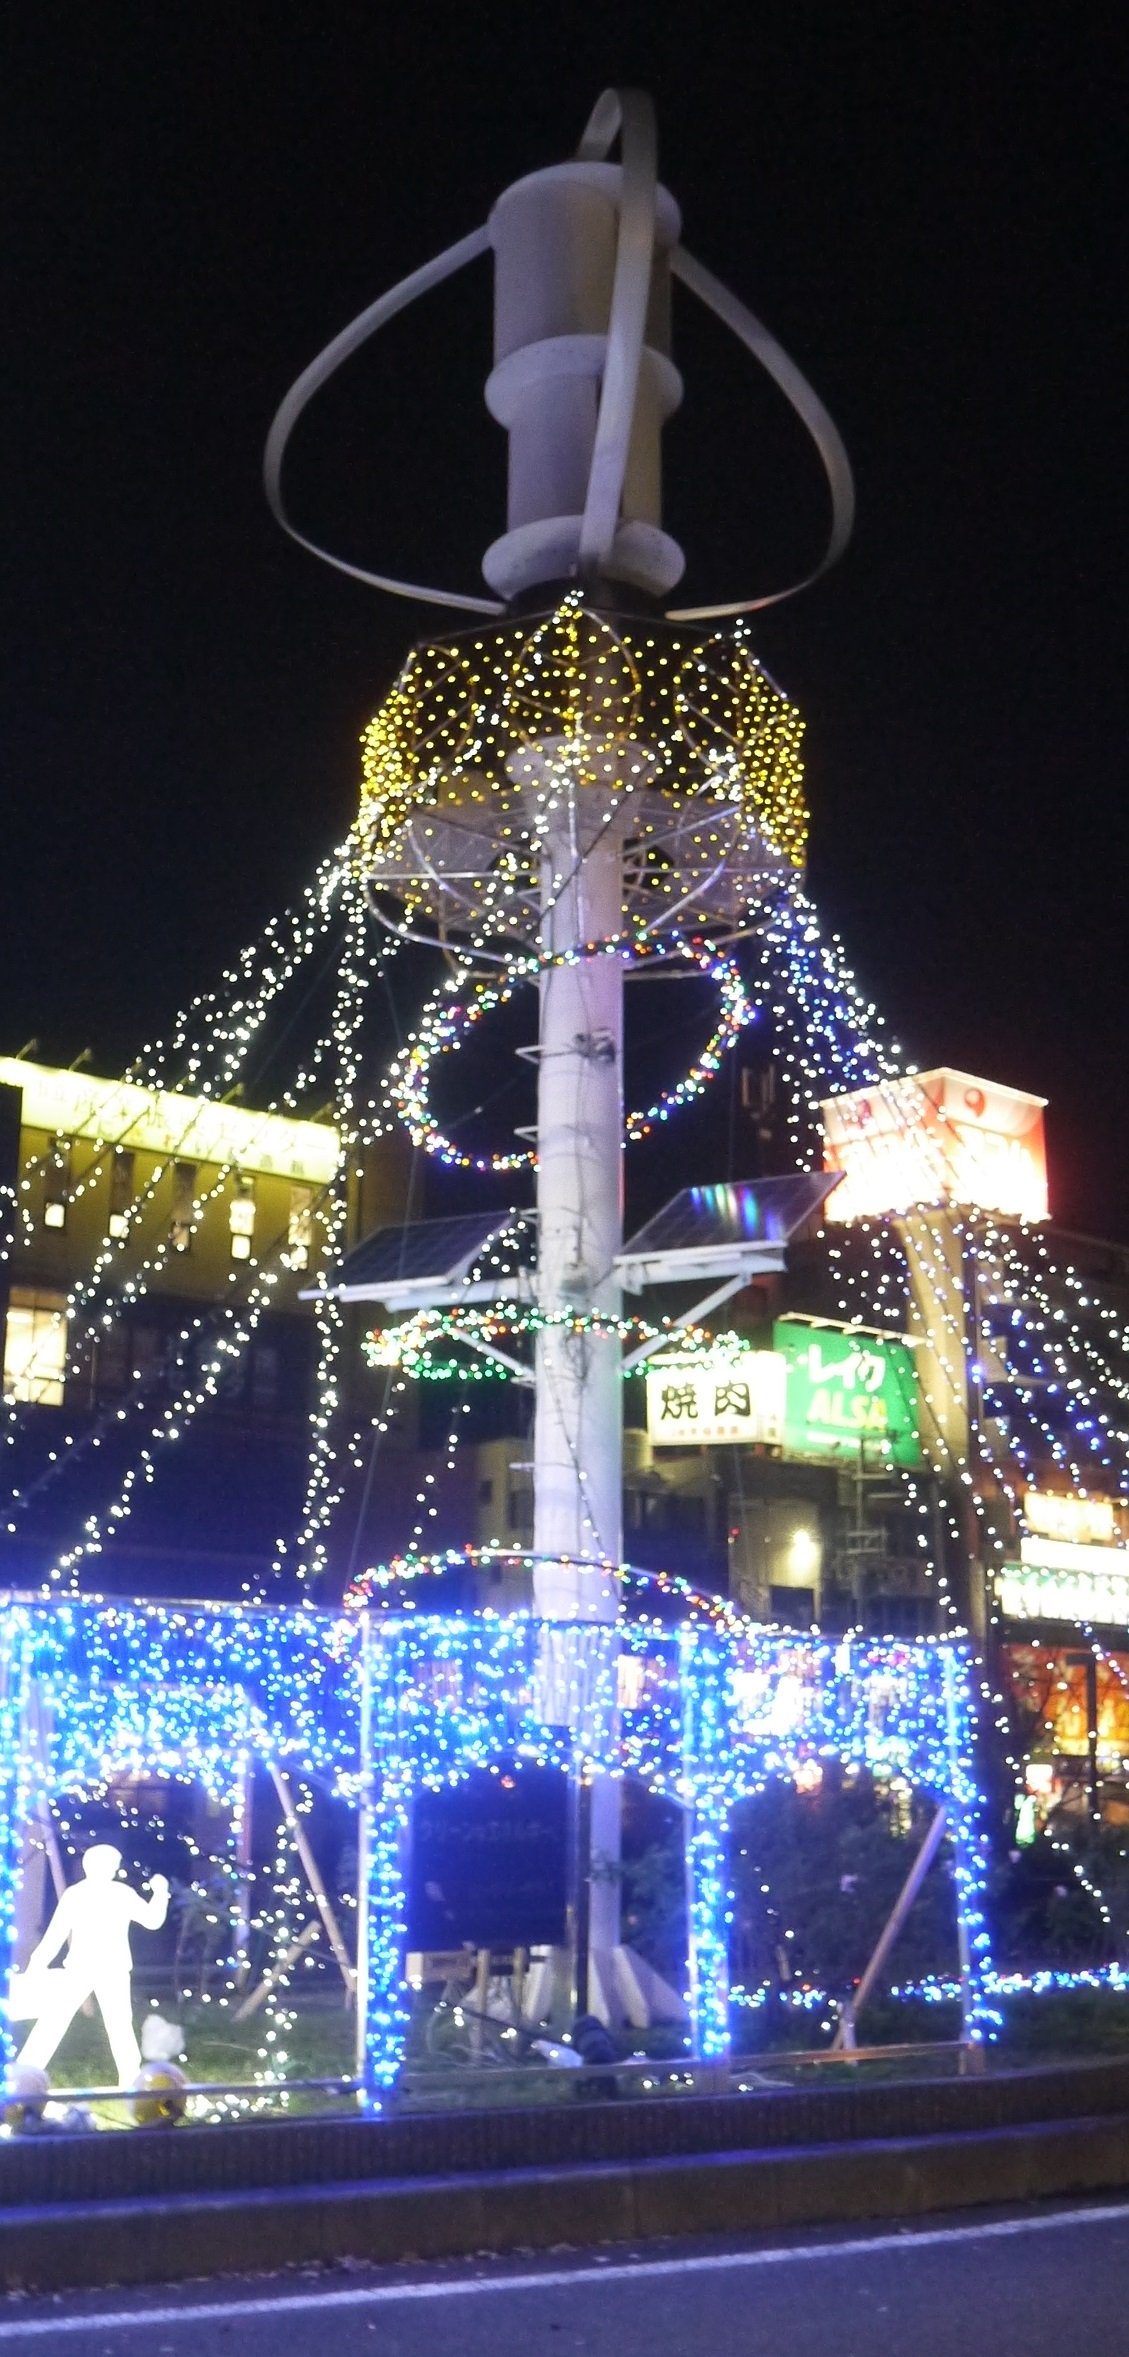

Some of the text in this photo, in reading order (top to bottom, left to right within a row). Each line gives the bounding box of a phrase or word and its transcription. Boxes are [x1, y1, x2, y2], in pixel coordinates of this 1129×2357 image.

[808, 1344, 886, 1393] レイク
[660, 1380, 752, 1420] 焼肉
[806, 1389, 888, 1433] ALSA
